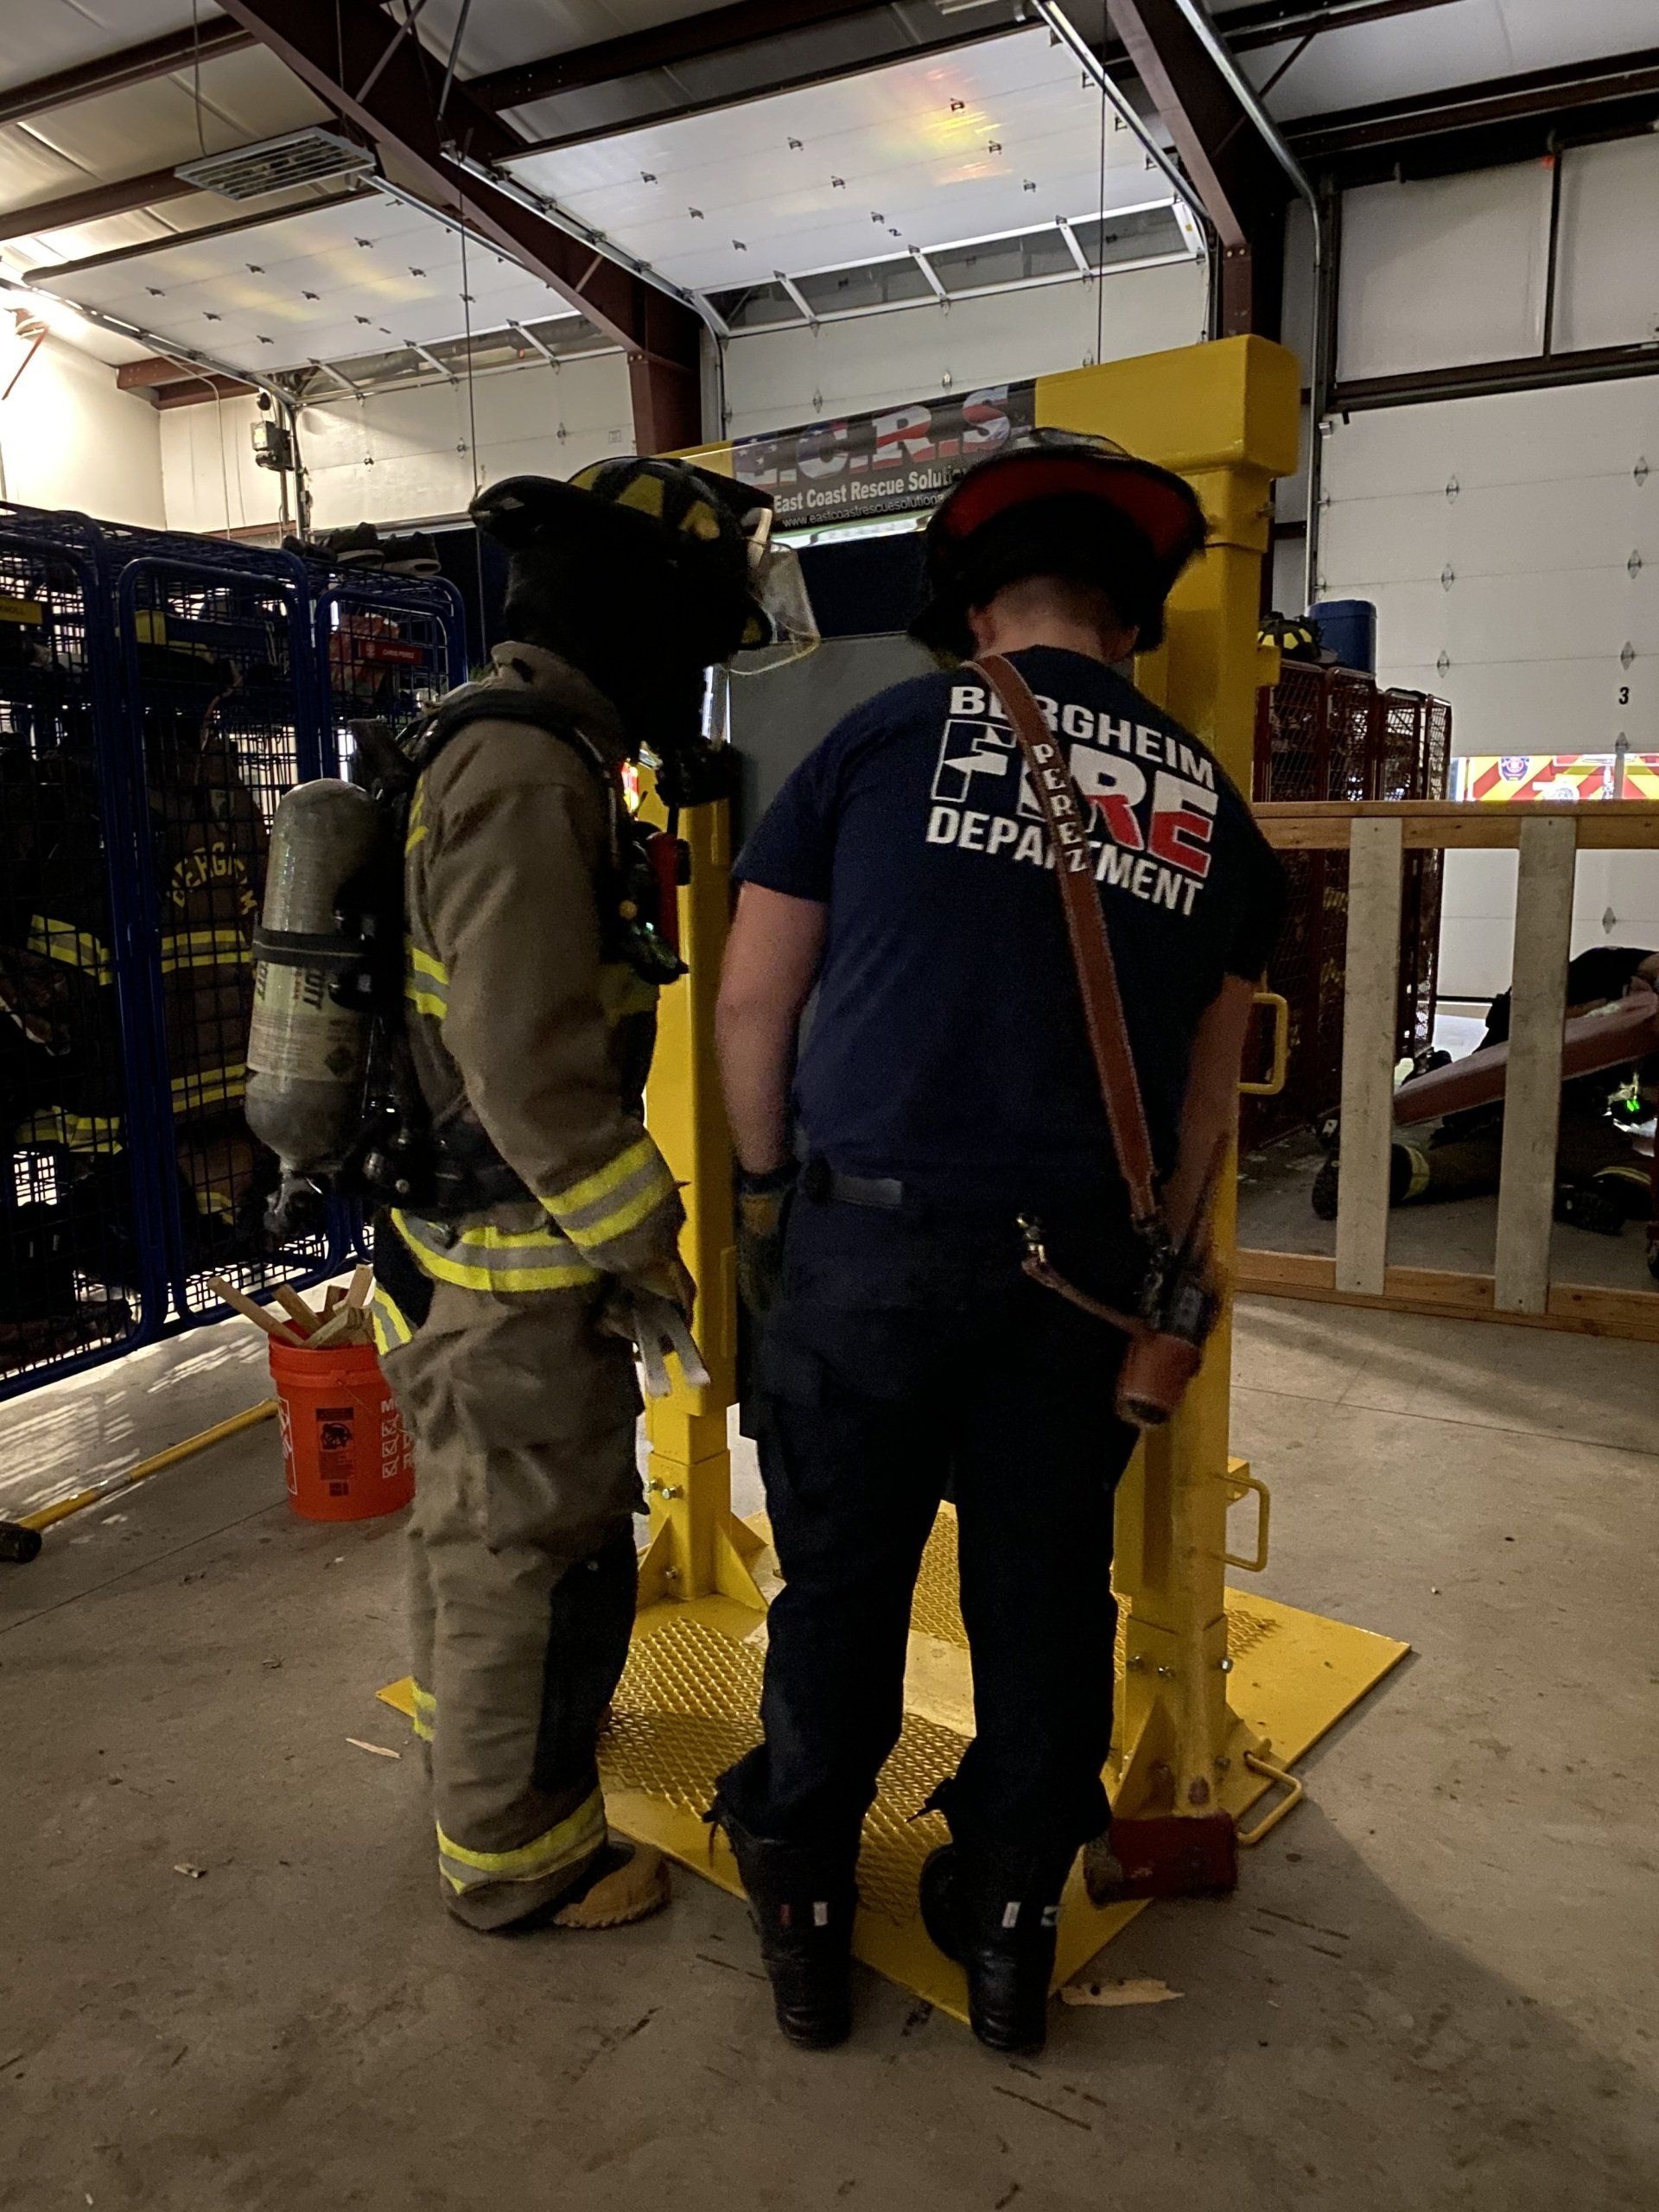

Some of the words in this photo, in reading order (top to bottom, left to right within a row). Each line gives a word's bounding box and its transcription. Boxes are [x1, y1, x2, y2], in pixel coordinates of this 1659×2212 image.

[774, 493, 804, 513] East
[806, 484, 847, 507] Coast
[850, 478, 905, 501] Rescue
[1618, 686, 1630, 705] 3
[1033, 743, 1089, 873] PEREZ
[925, 805, 1204, 916] DEPAMENT
